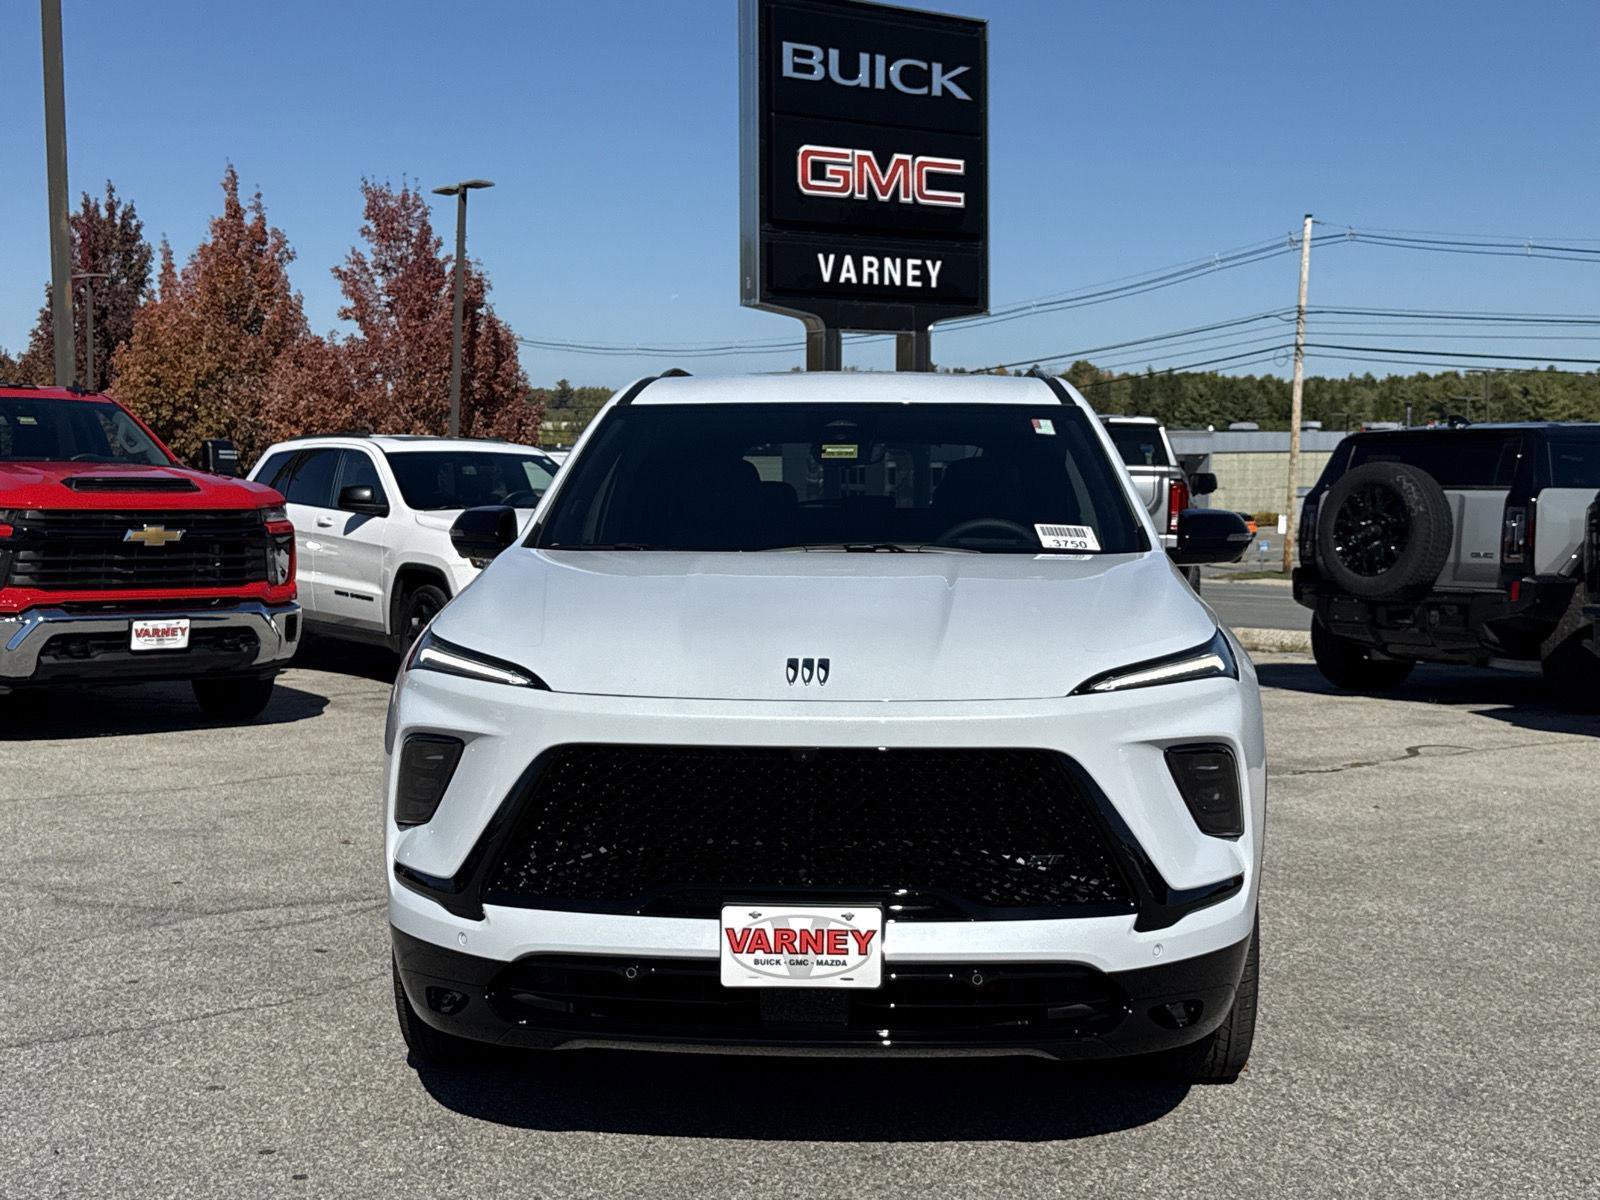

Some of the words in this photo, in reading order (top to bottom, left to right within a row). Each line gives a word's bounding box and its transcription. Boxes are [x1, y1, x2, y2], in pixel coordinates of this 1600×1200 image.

[781, 40, 973, 101] BUICK
[797, 144, 966, 208] GMC
[817, 252, 942, 288] VARNEY
[1052, 539, 1088, 549] 3750
[134, 626, 188, 638] VARNEY
[725, 928, 877, 956] VARNEY
[753, 958, 782, 966] BUICK
[788, 958, 809, 967] GMC
[816, 959, 847, 967] MAZDA
